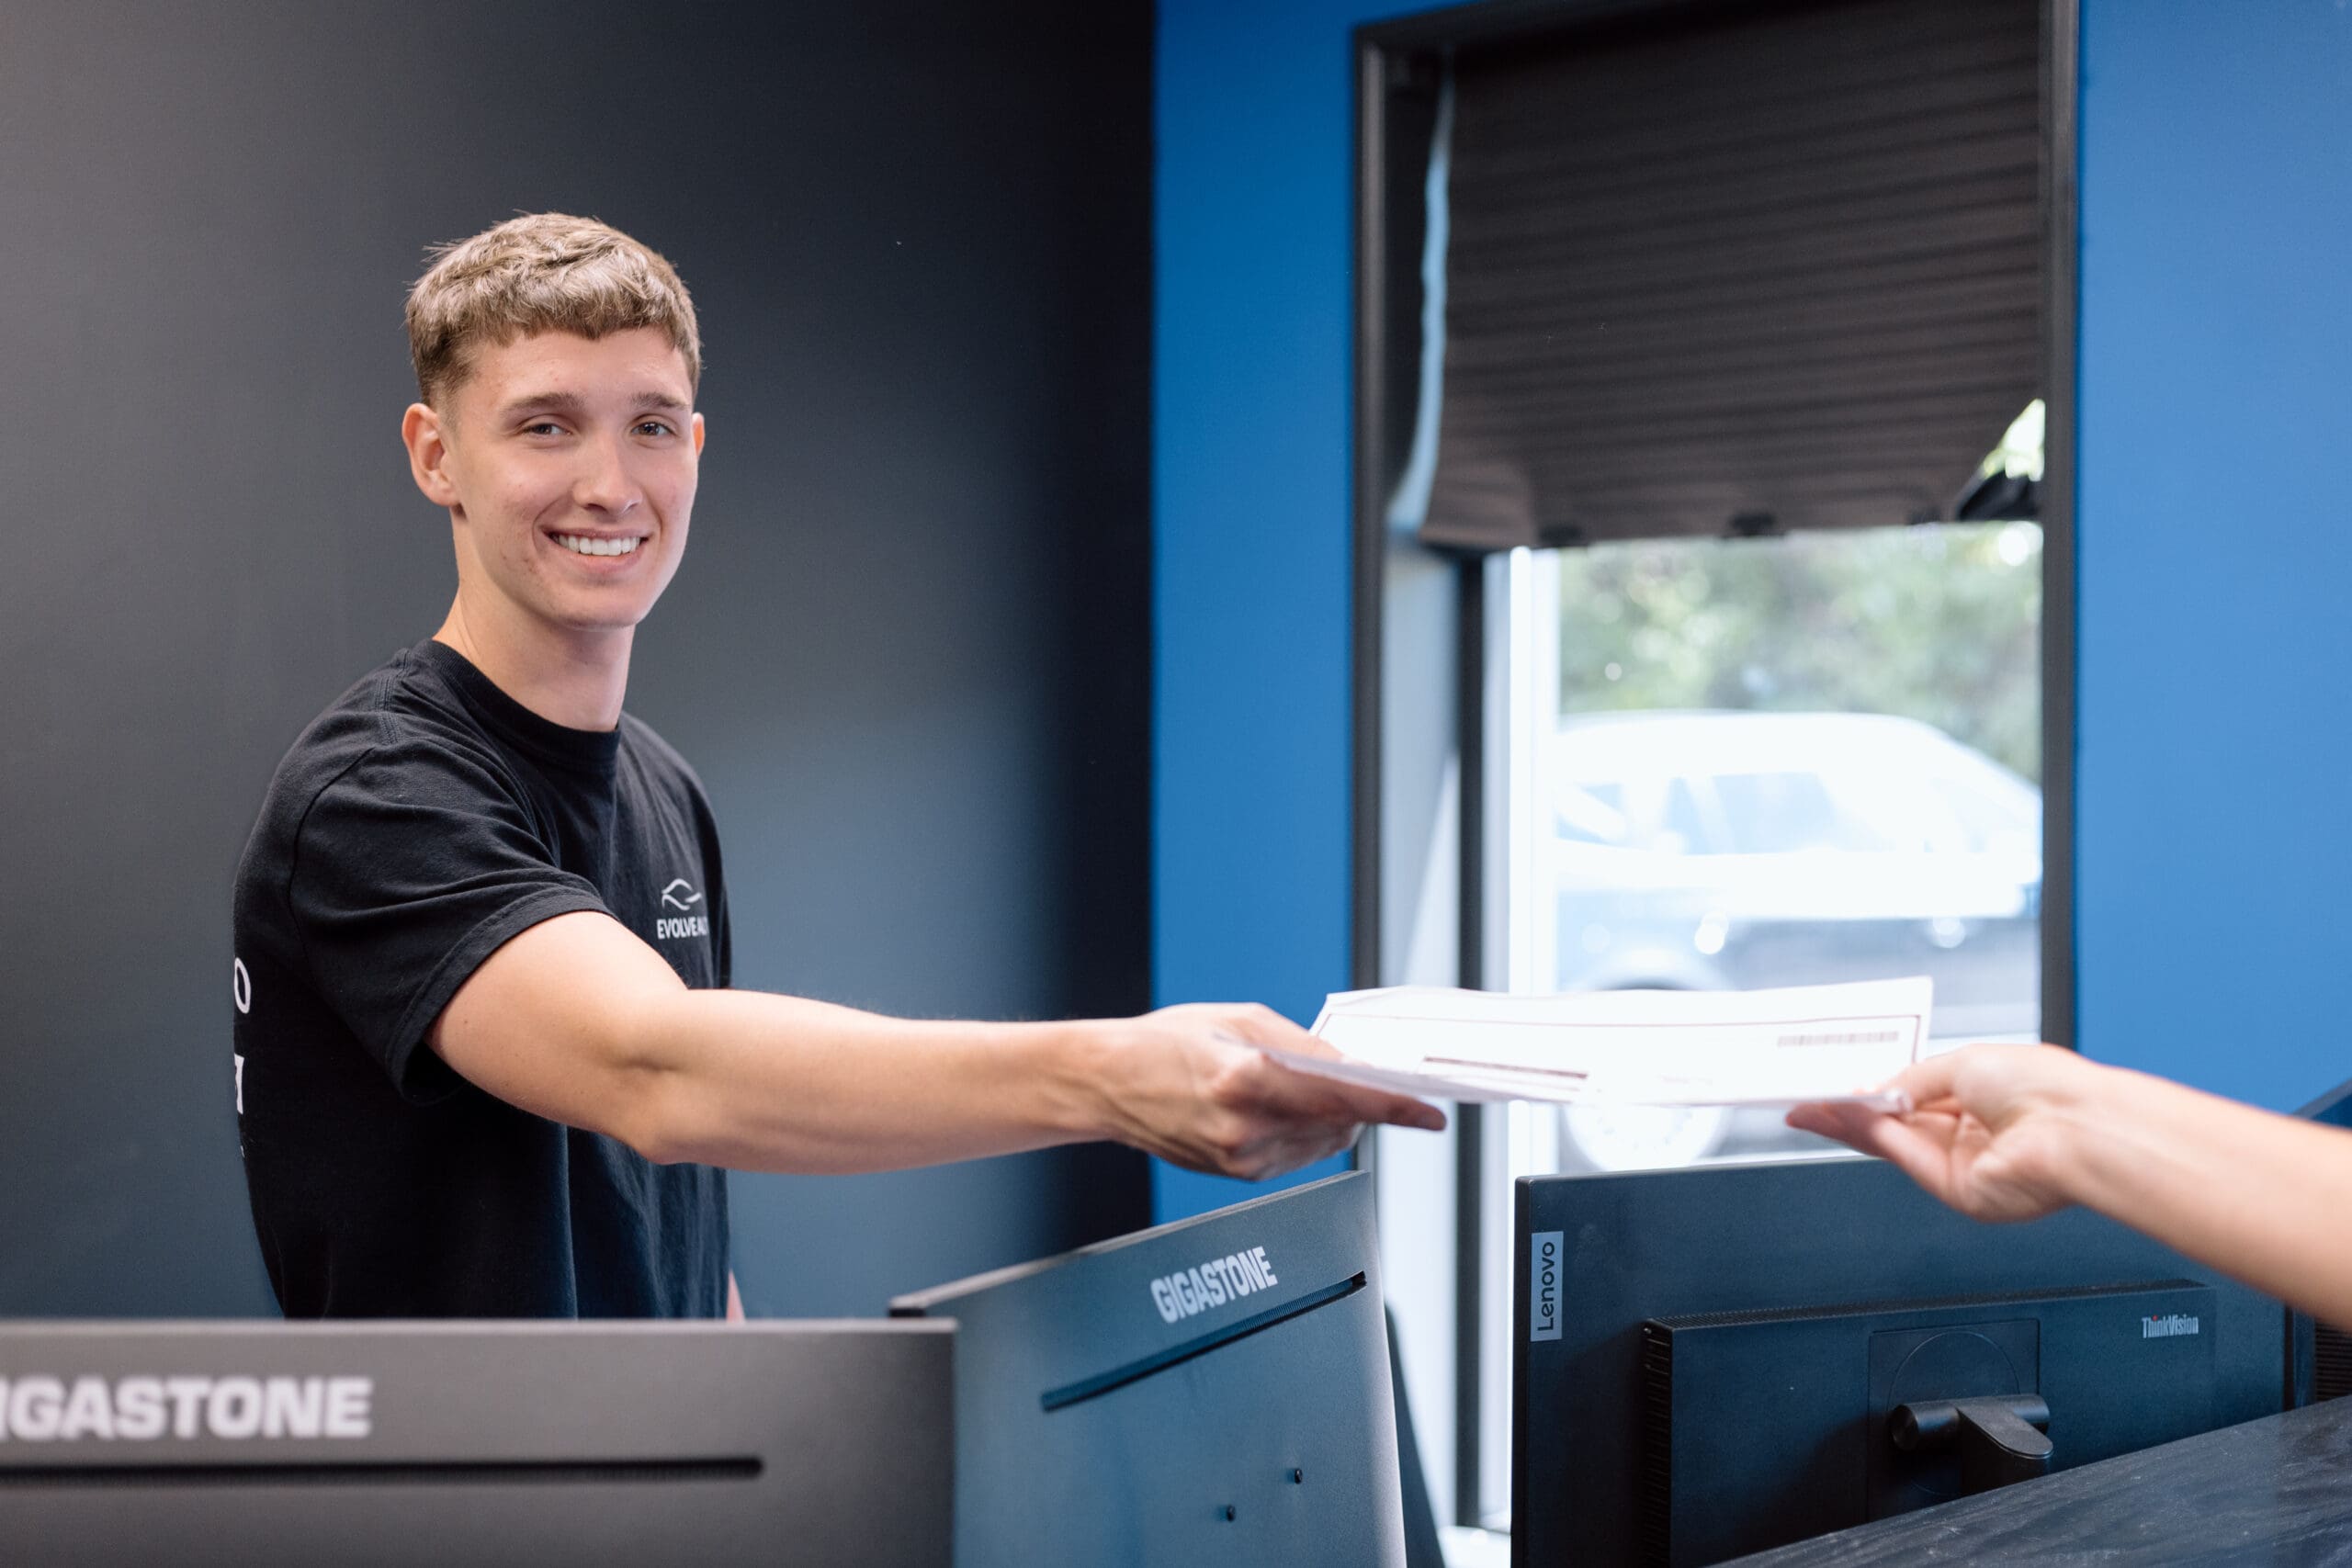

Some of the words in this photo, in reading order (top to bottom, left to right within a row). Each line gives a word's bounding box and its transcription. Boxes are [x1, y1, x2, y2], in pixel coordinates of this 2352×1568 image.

[656, 917, 697, 940] EVOLVE
[1150, 1246, 1278, 1324] GIGASTONE
[1537, 1241, 1555, 1332] Lenovo
[2141, 1314, 2199, 1338] ThinkVision
